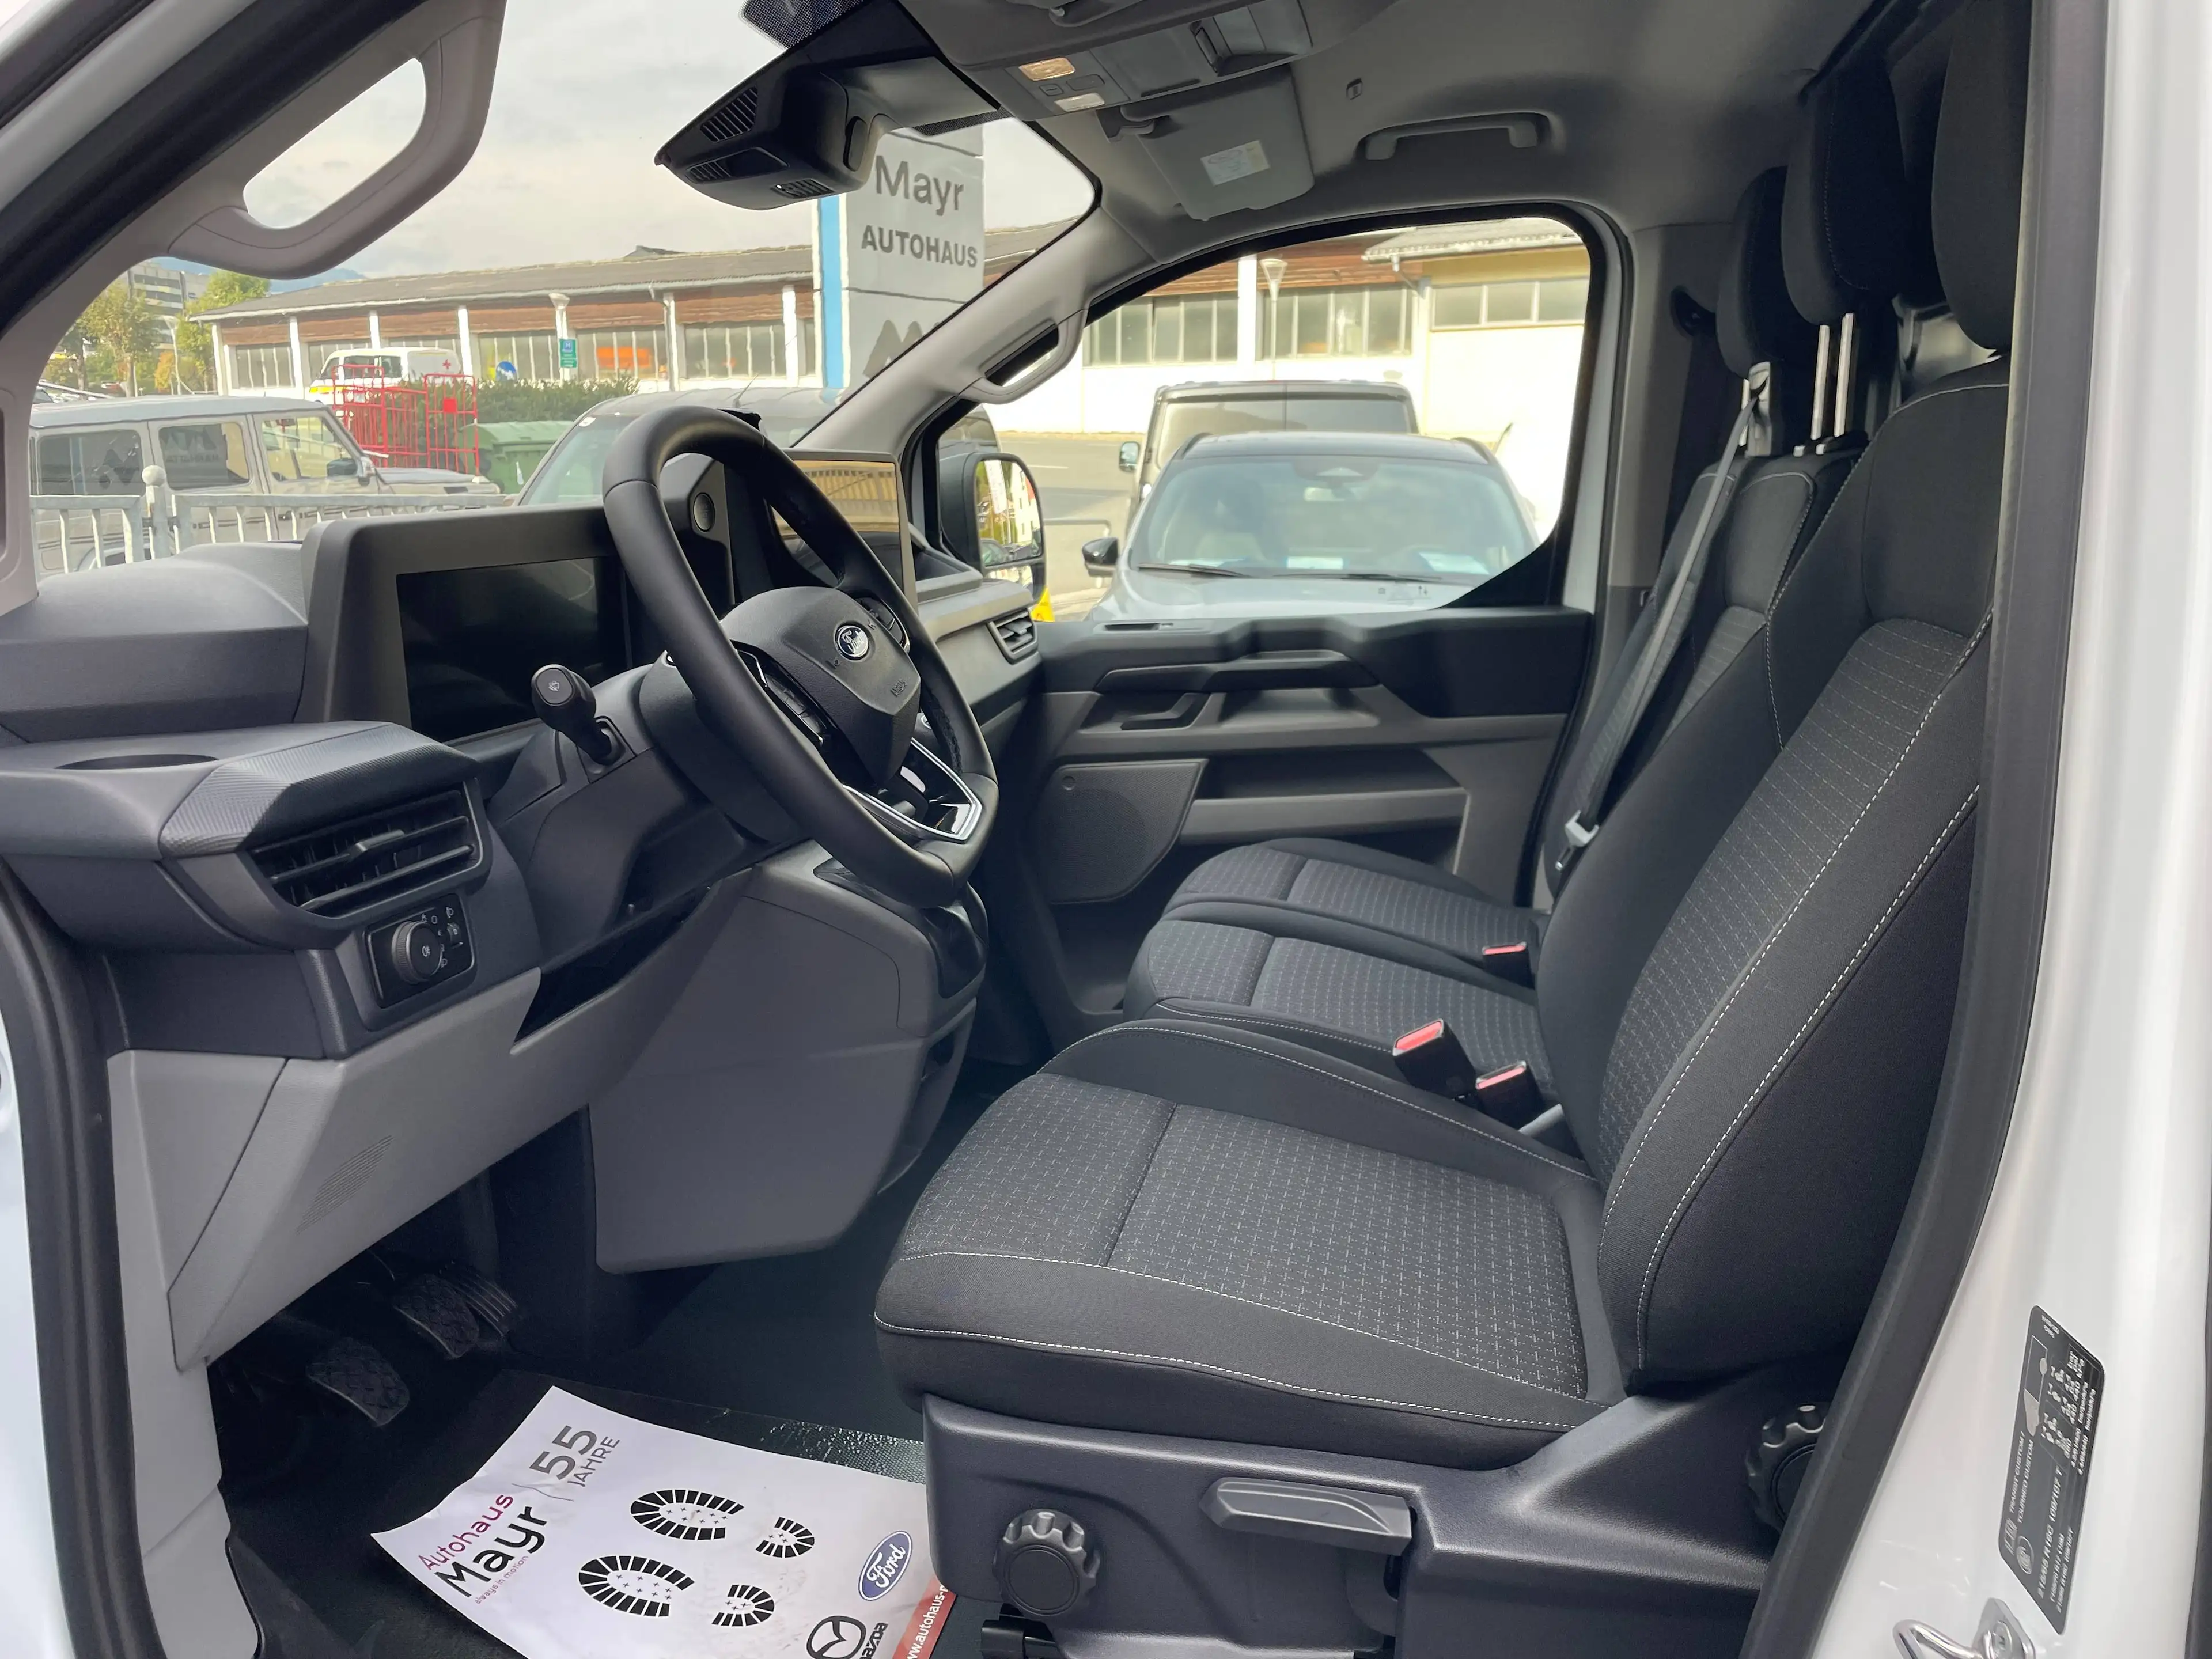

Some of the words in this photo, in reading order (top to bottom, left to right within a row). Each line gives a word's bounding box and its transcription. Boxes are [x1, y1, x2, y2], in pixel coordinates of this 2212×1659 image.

[875, 155, 964, 216] Mayr
[861, 225, 978, 268] AUTOHAUS
[529, 1425, 597, 1480] 55
[567, 1436, 620, 1487] JAHRE
[2014, 1437, 2024, 1477] CUSTOM
[418, 1494, 514, 1570] Autohaus
[434, 1506, 548, 1598] Mayr
[474, 1584, 499, 1604] always
[503, 1556, 529, 1578] motion
[866, 1543, 906, 1589] Ford
[859, 1622, 889, 1659] azda
